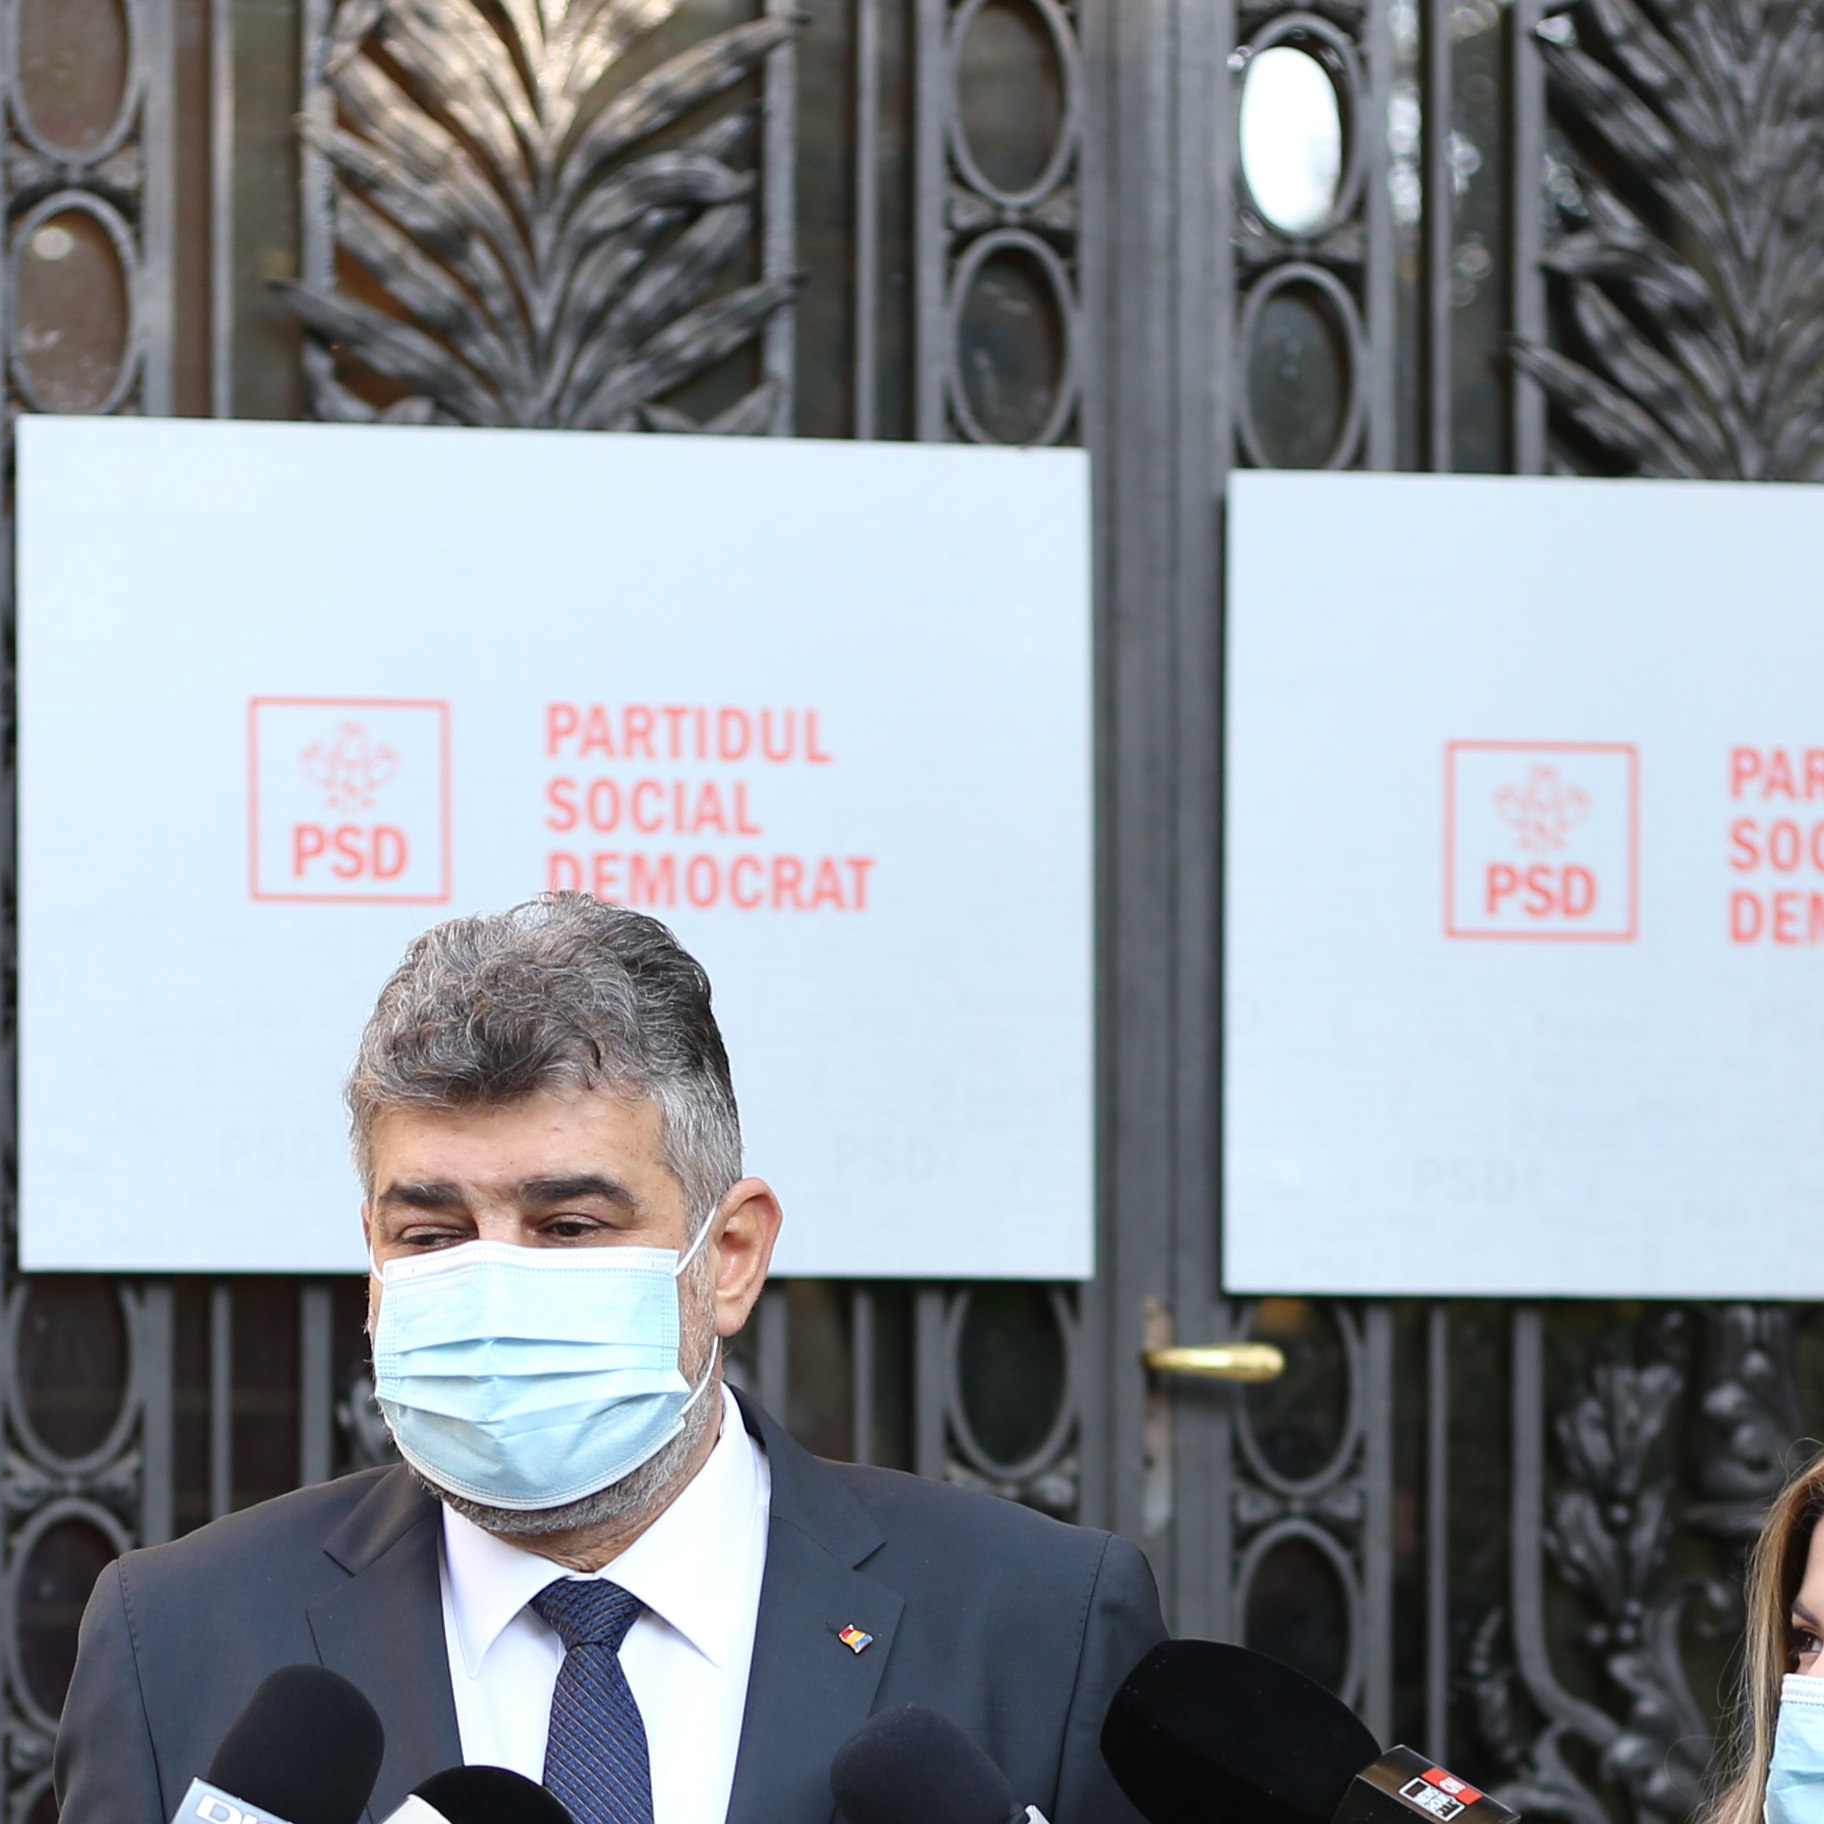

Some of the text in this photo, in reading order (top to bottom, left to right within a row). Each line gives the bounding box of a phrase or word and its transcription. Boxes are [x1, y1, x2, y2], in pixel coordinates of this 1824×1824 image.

[545, 702, 834, 766] PARTIDUL
[545, 776, 763, 837] SOCIAL
[291, 823, 410, 881] PSD
[547, 851, 876, 911] DEMOCRAT
[1485, 863, 1598, 919] PSD
